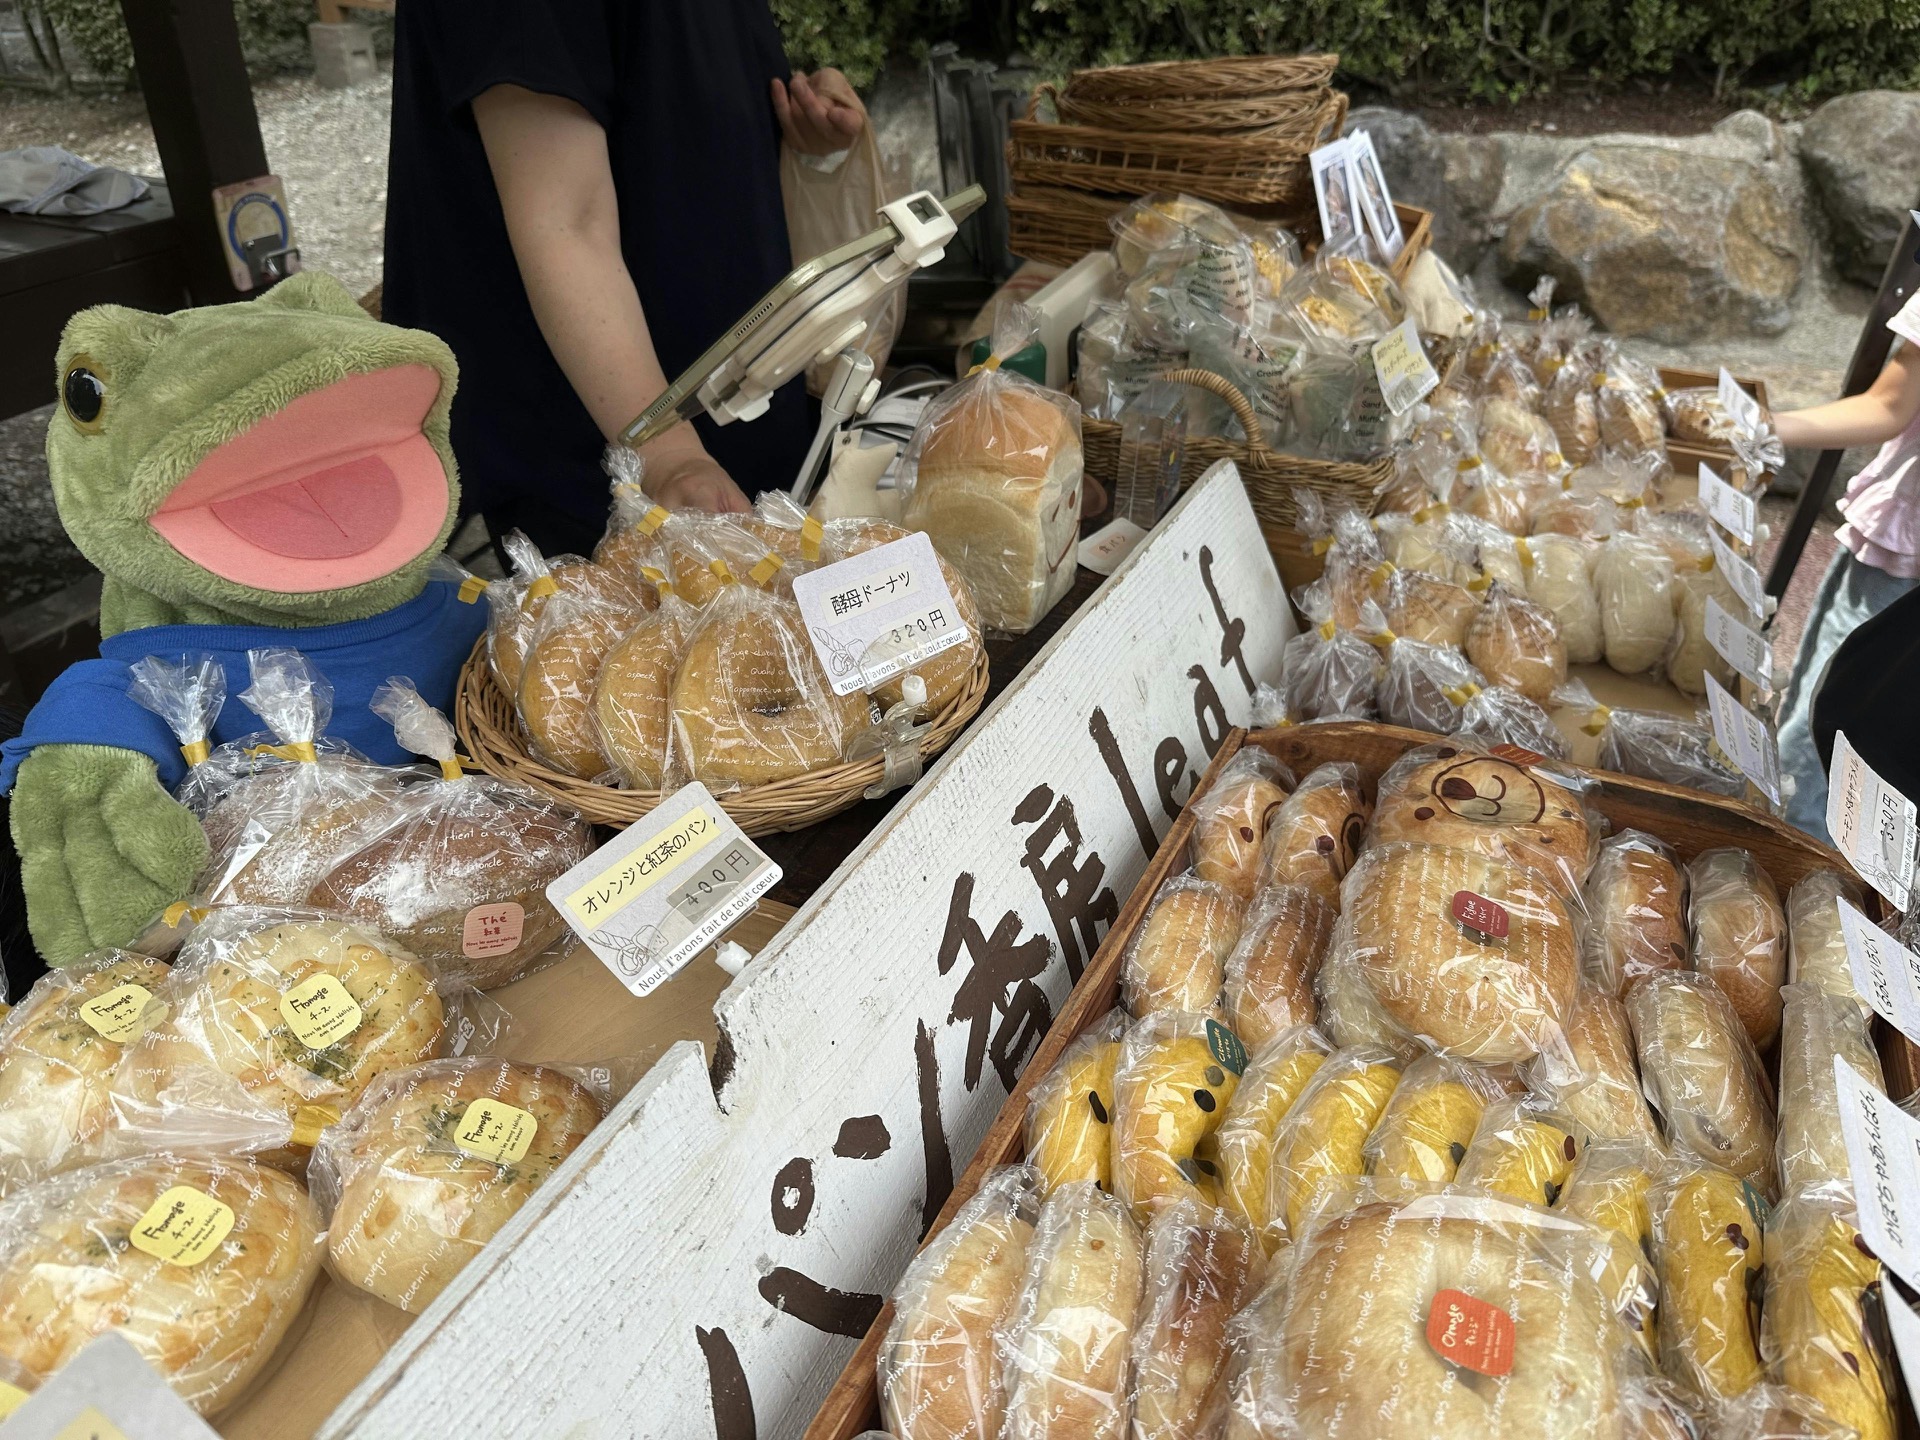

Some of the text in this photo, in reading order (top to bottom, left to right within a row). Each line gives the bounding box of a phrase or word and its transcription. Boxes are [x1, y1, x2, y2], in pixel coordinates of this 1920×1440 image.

[830, 570, 911, 617] 酵母ドーナツ
[891, 608, 947, 644] 320円
[840, 677, 865, 692] Nous
[1088, 545, 1256, 861] leaf
[1879, 792, 1899, 842] 350円
[582, 818, 708, 914] オレンジと紅茶のパン
[684, 849, 751, 907] 400円
[478, 911, 507, 926] Thé
[638, 967, 666, 991] Nous
[665, 934, 704, 968] l'avons
[701, 922, 721, 942] fait
[720, 908, 734, 922] de
[733, 893, 753, 912] tout
[1860, 928, 1894, 1016] くるみといちじく
[290, 987, 329, 1014] Fromage
[463, 1110, 492, 1143] Fromage
[1858, 1089, 1904, 1249] かぼちゃあんぱん
[142, 1201, 185, 1240] Fromage
[1441, 1304, 1466, 1348] Orange
